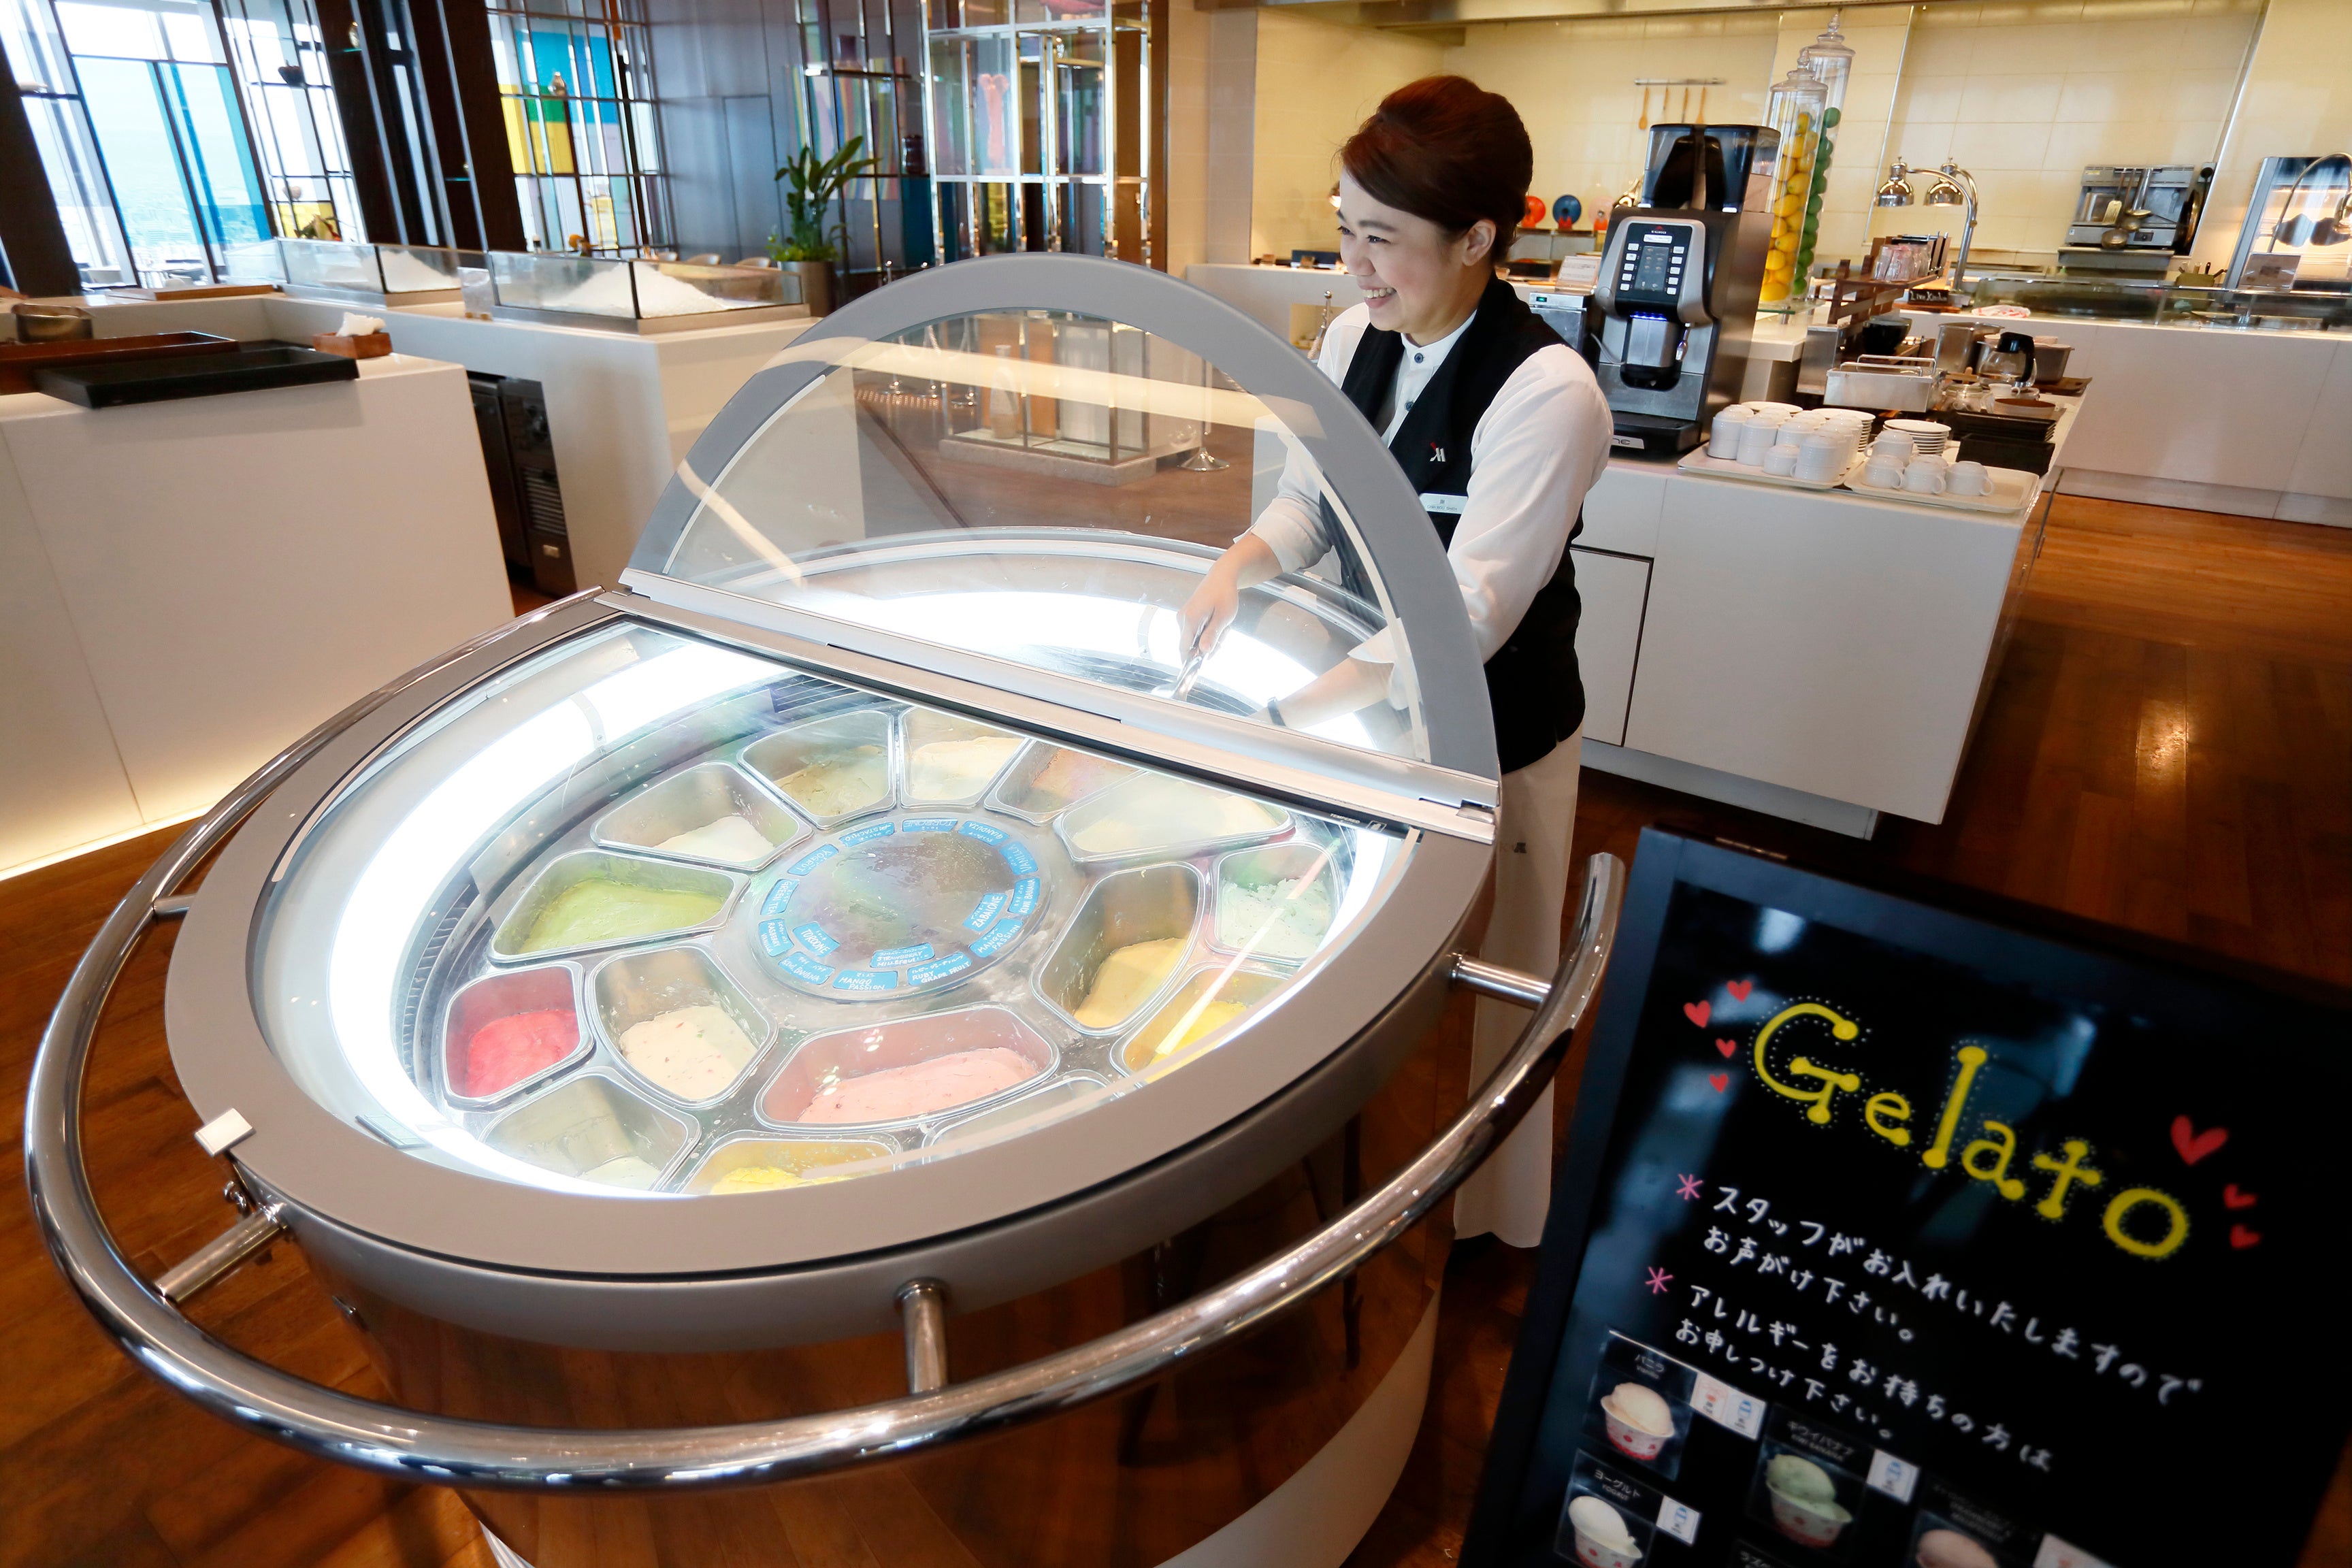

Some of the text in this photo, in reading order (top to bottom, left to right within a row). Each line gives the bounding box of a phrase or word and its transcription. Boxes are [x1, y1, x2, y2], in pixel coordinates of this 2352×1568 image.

[773, 881, 792, 902] GREEN
[972, 896, 1003, 928] ZABAIONE
[977, 932, 1003, 953] MANGO
[991, 925, 1020, 950] PASSION
[838, 977, 872, 985] MANGO
[912, 970, 934, 981] RUBY
[921, 961, 970, 983] GRAPE FRUIT
[1752, 1001, 2190, 1258] Gelato
[1703, 1225, 1914, 1342] お声がけ下さい。
[1713, 1186, 2203, 1406] スタッフがお入れいたしますので
[1635, 1354, 1665, 1373] バニラ
[1676, 1318, 1893, 1439] お申しつけ下さい。
[1690, 1284, 2053, 1472] アレルギーをお持ちの方は
[1787, 1420, 1855, 1457] キウイバナナ
[1595, 1469, 1641, 1497] ヨーグルト
